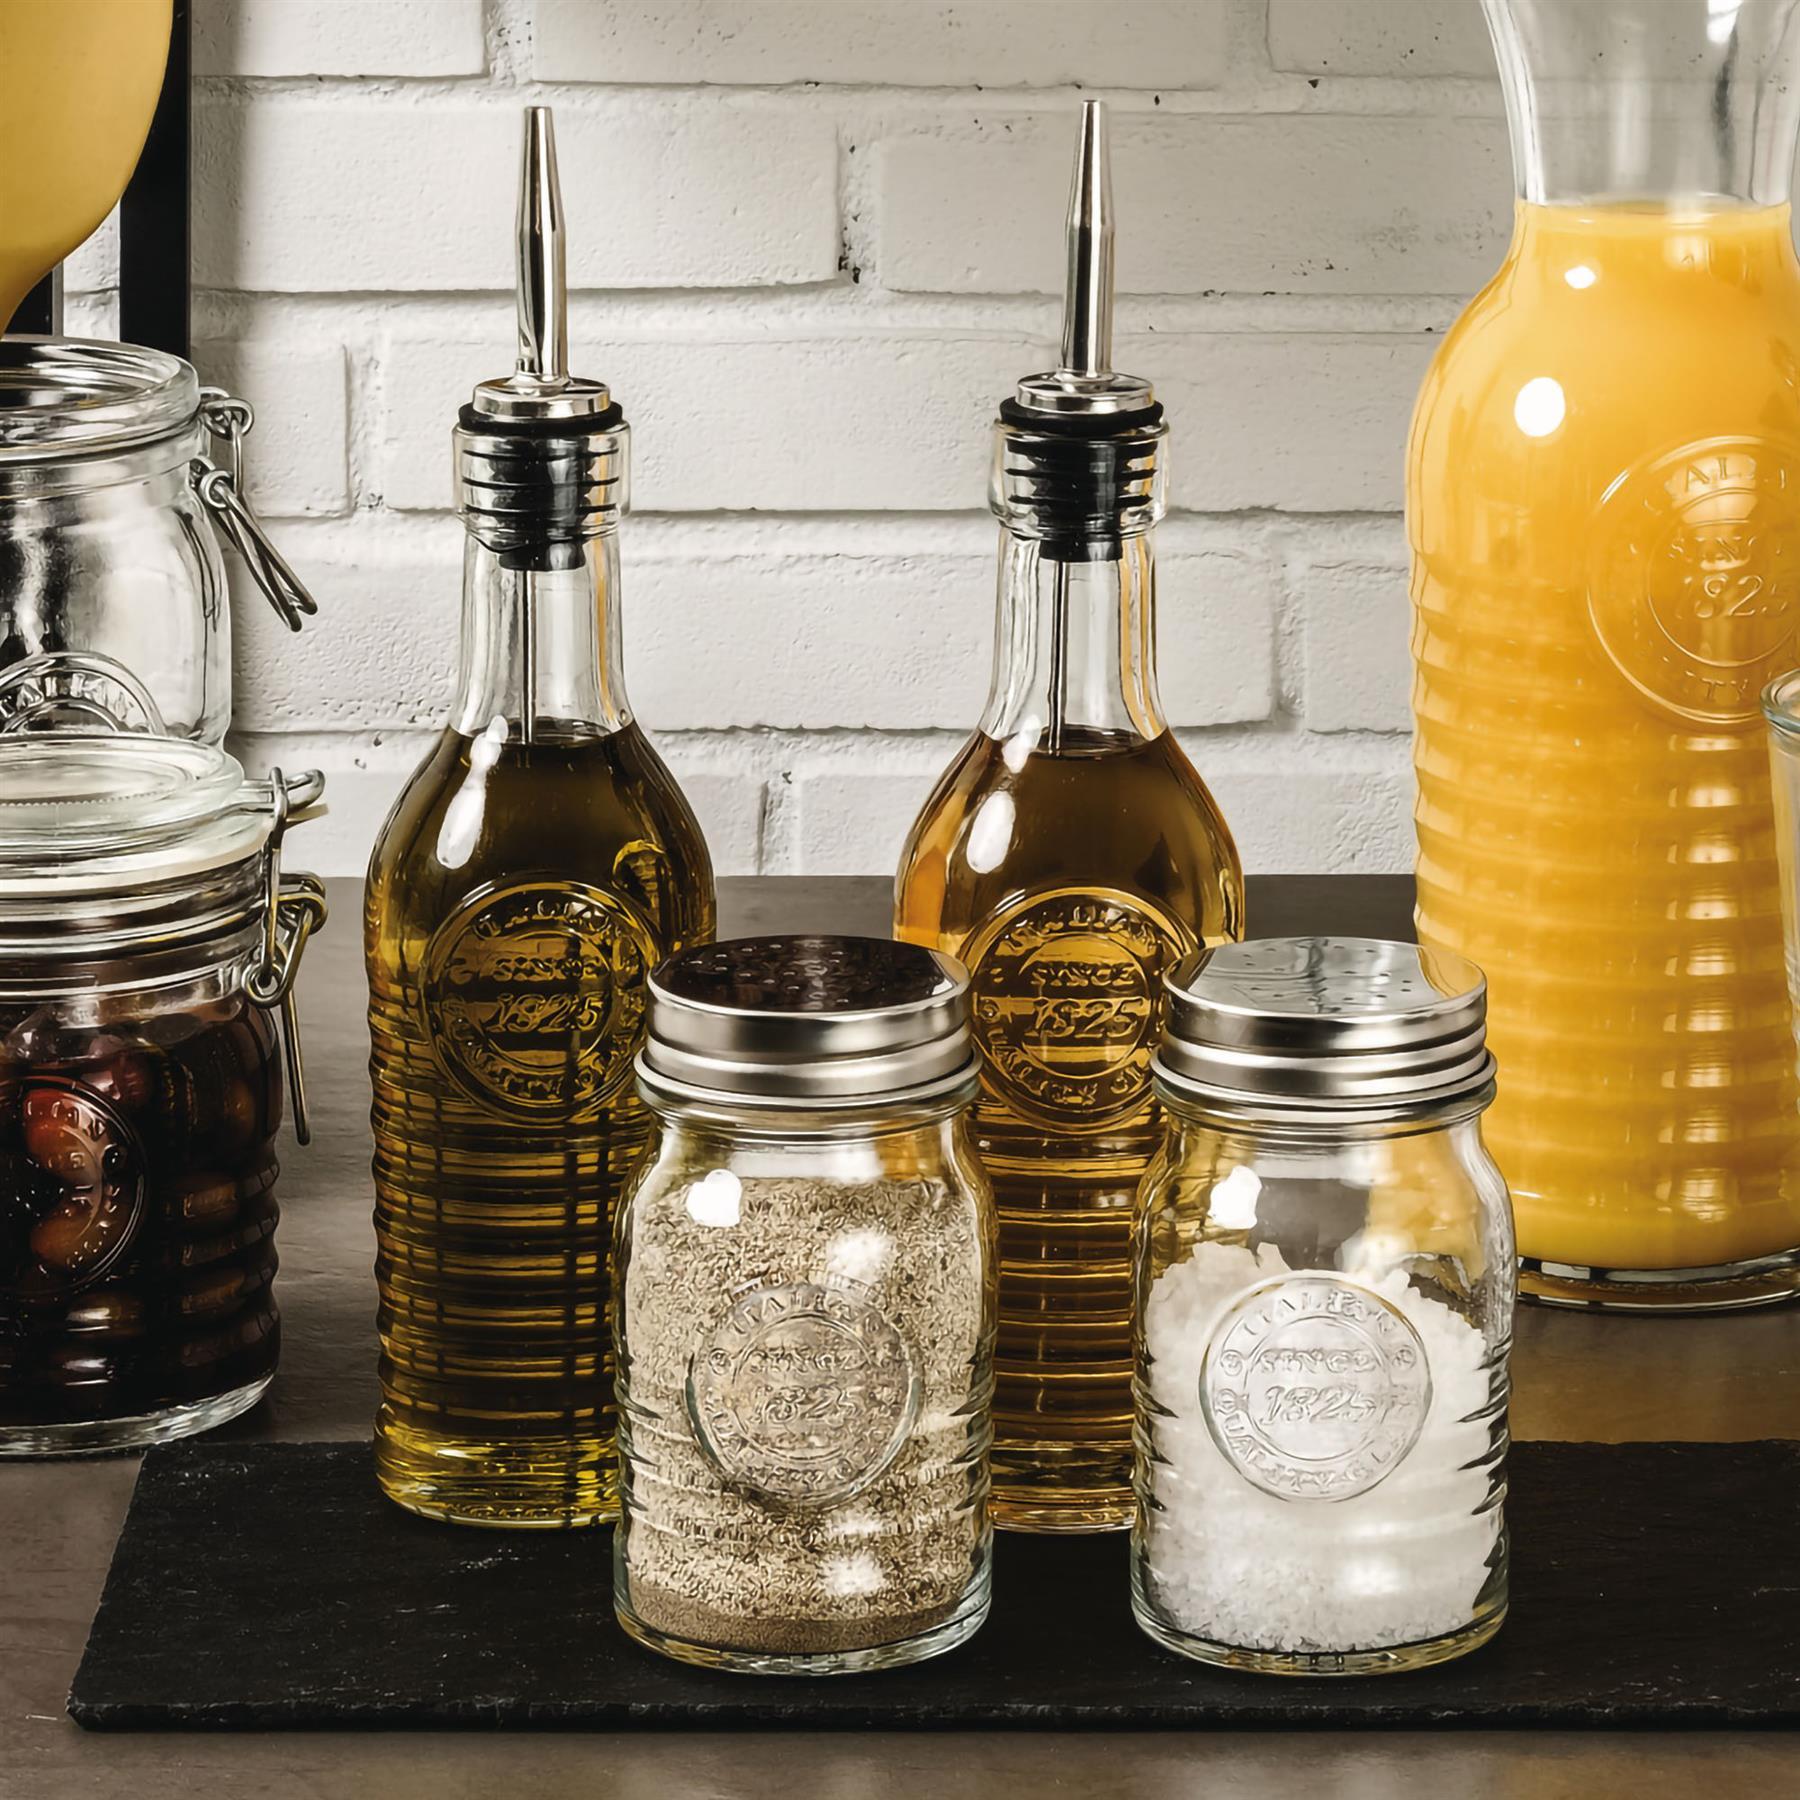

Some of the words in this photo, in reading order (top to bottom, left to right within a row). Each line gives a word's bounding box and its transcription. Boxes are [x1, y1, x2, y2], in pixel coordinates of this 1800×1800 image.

[483, 993, 604, 1034] 1825
[1025, 996, 1146, 1039] 1825
[1260, 1386, 1377, 1426] 1825
